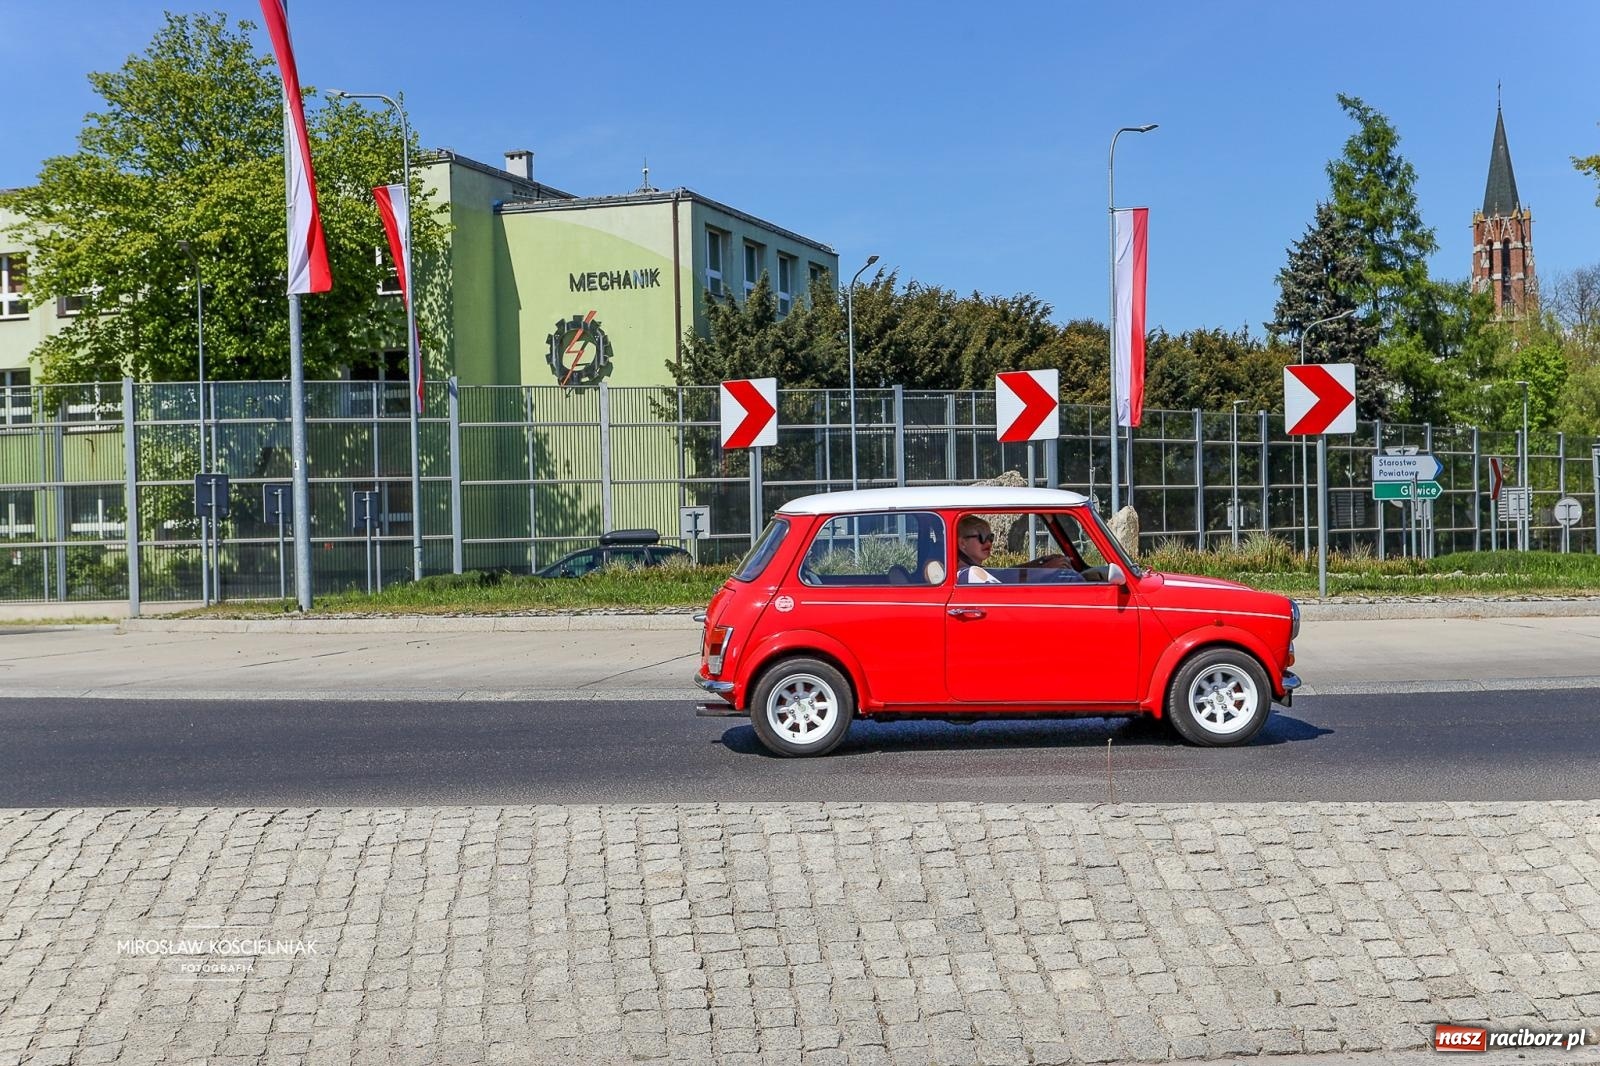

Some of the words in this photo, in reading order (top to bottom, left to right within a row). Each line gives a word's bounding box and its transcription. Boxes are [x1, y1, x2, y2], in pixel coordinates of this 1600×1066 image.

[569, 268, 661, 292] MECHANIK
[1378, 459, 1417, 467] Starostwo
[1400, 485, 1437, 496] Glwice
